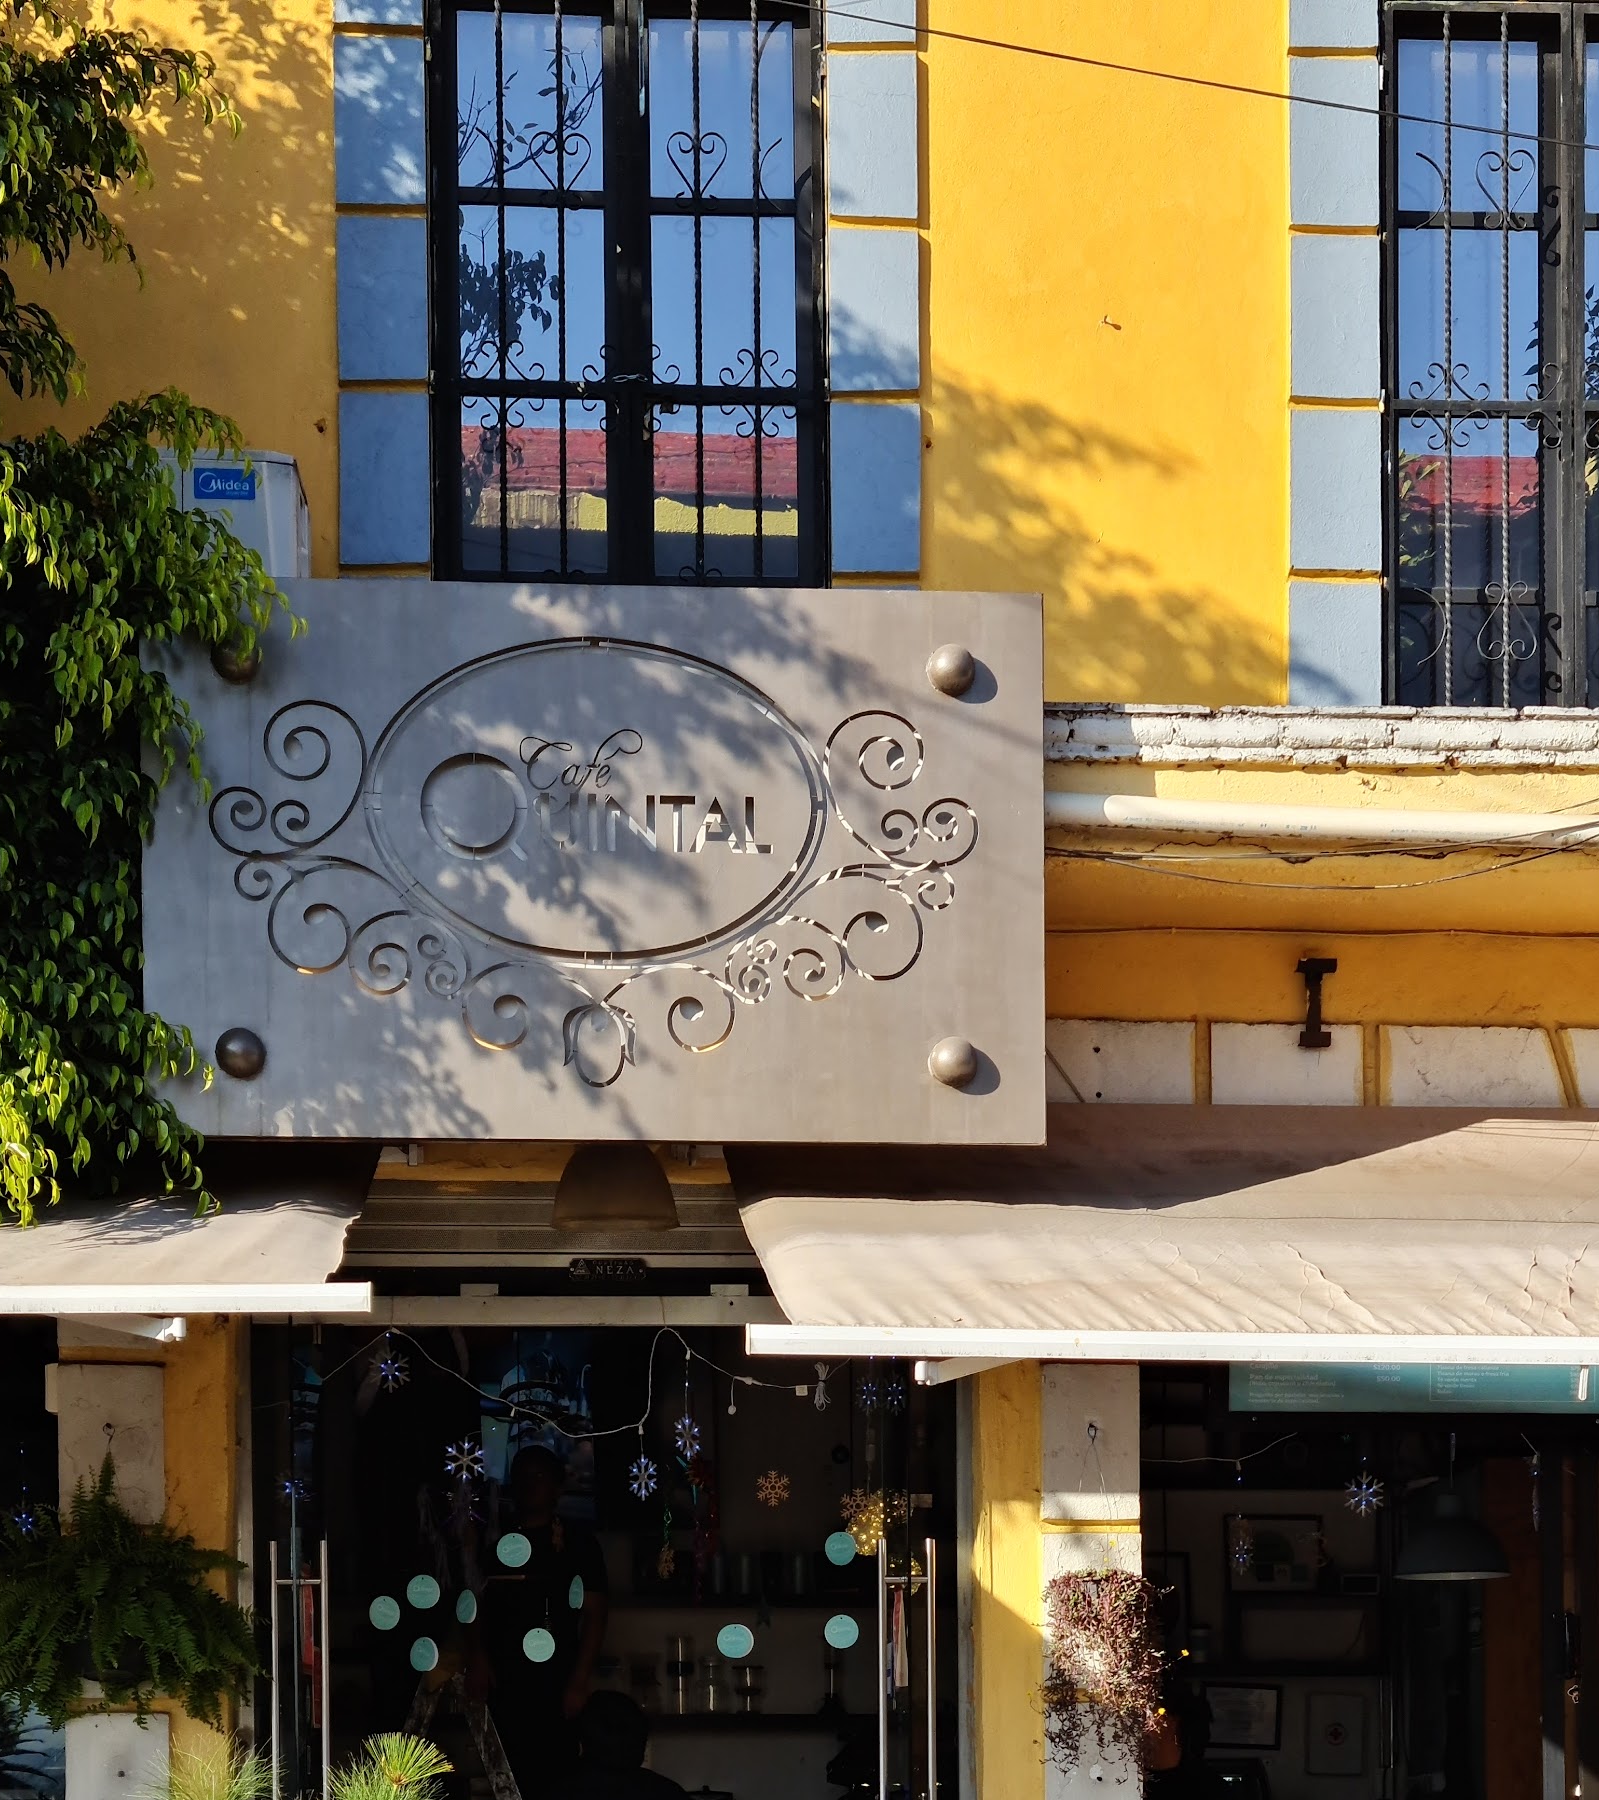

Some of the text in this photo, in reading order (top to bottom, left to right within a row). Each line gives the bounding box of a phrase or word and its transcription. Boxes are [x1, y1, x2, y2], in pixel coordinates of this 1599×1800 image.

[520, 730, 643, 793] Café
[420, 752, 774, 861] QUINTAL
[596, 1265, 635, 1275] NEZA
[203, 1476, 250, 1492] Midea
